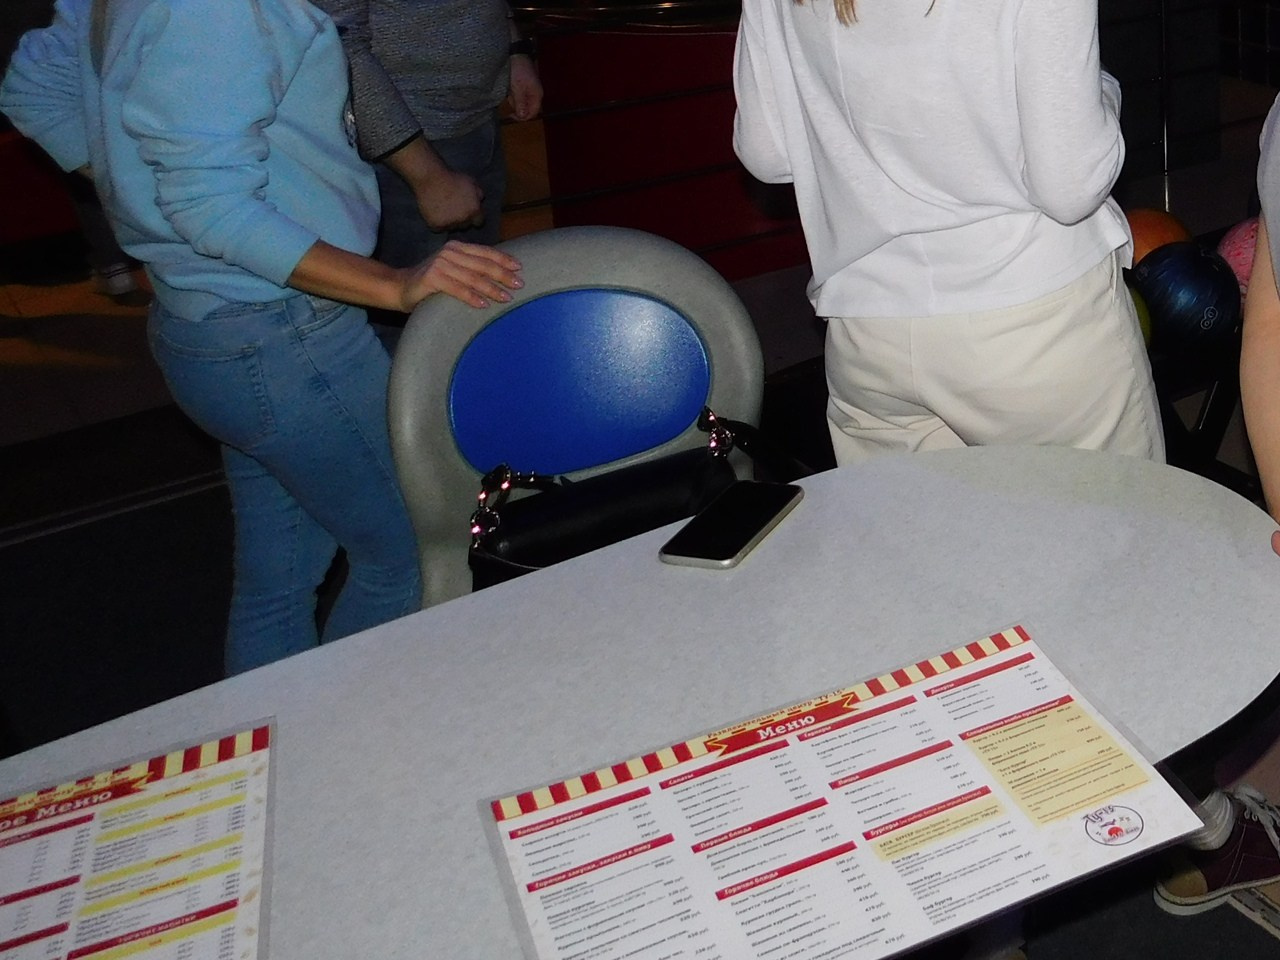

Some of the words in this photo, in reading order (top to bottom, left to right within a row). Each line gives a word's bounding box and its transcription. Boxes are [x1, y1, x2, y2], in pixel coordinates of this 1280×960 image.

[755, 712, 816, 740] Меню
[37, 791, 112, 820] Меню
[869, 821, 900, 836] Бургеры
